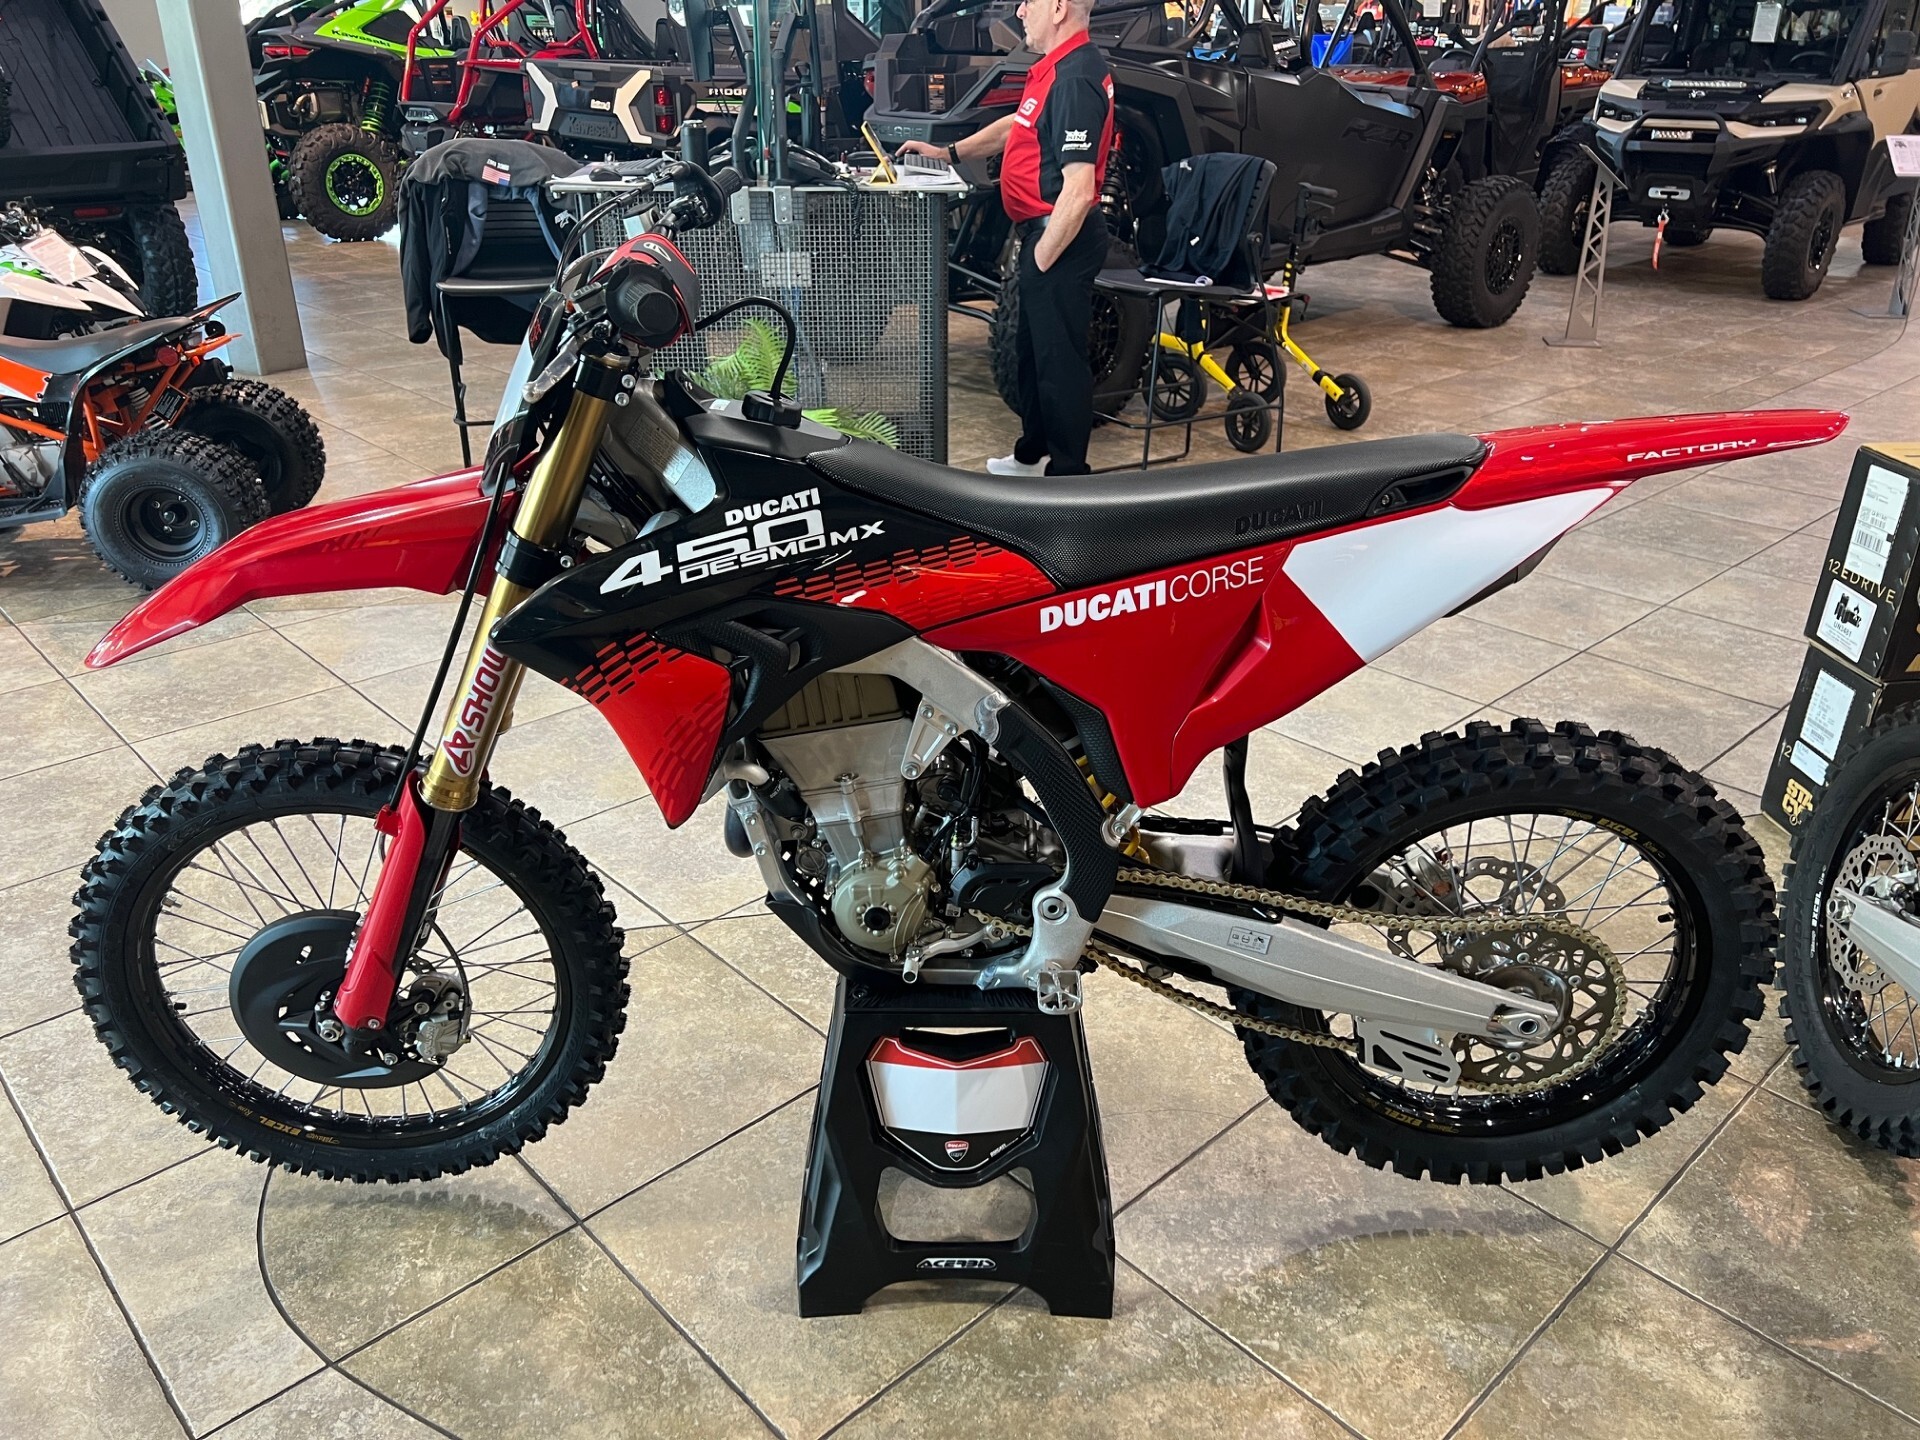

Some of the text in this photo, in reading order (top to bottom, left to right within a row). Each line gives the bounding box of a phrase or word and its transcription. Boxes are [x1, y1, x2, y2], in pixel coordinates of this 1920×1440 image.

[331, 29, 391, 48] Kawasaki
[567, 115, 618, 139] Kawasaki
[871, 123, 924, 138] POLARIS
[1626, 438, 1757, 463] FACTORY
[724, 487, 821, 527] DUCATI
[1235, 498, 1325, 535] DUCATI
[599, 509, 824, 595] 450
[679, 519, 887, 585] DESMO MX
[1039, 556, 1265, 634] DUCATI CORSE
[461, 647, 510, 734] SHOW
[1597, 818, 1640, 841] EXCEL
[1811, 890, 1822, 928] EXCEL
[259, 1115, 302, 1136] EXCEL
[1384, 1107, 1423, 1127] EXCEL
[917, 1257, 997, 1270] ACERBIS
